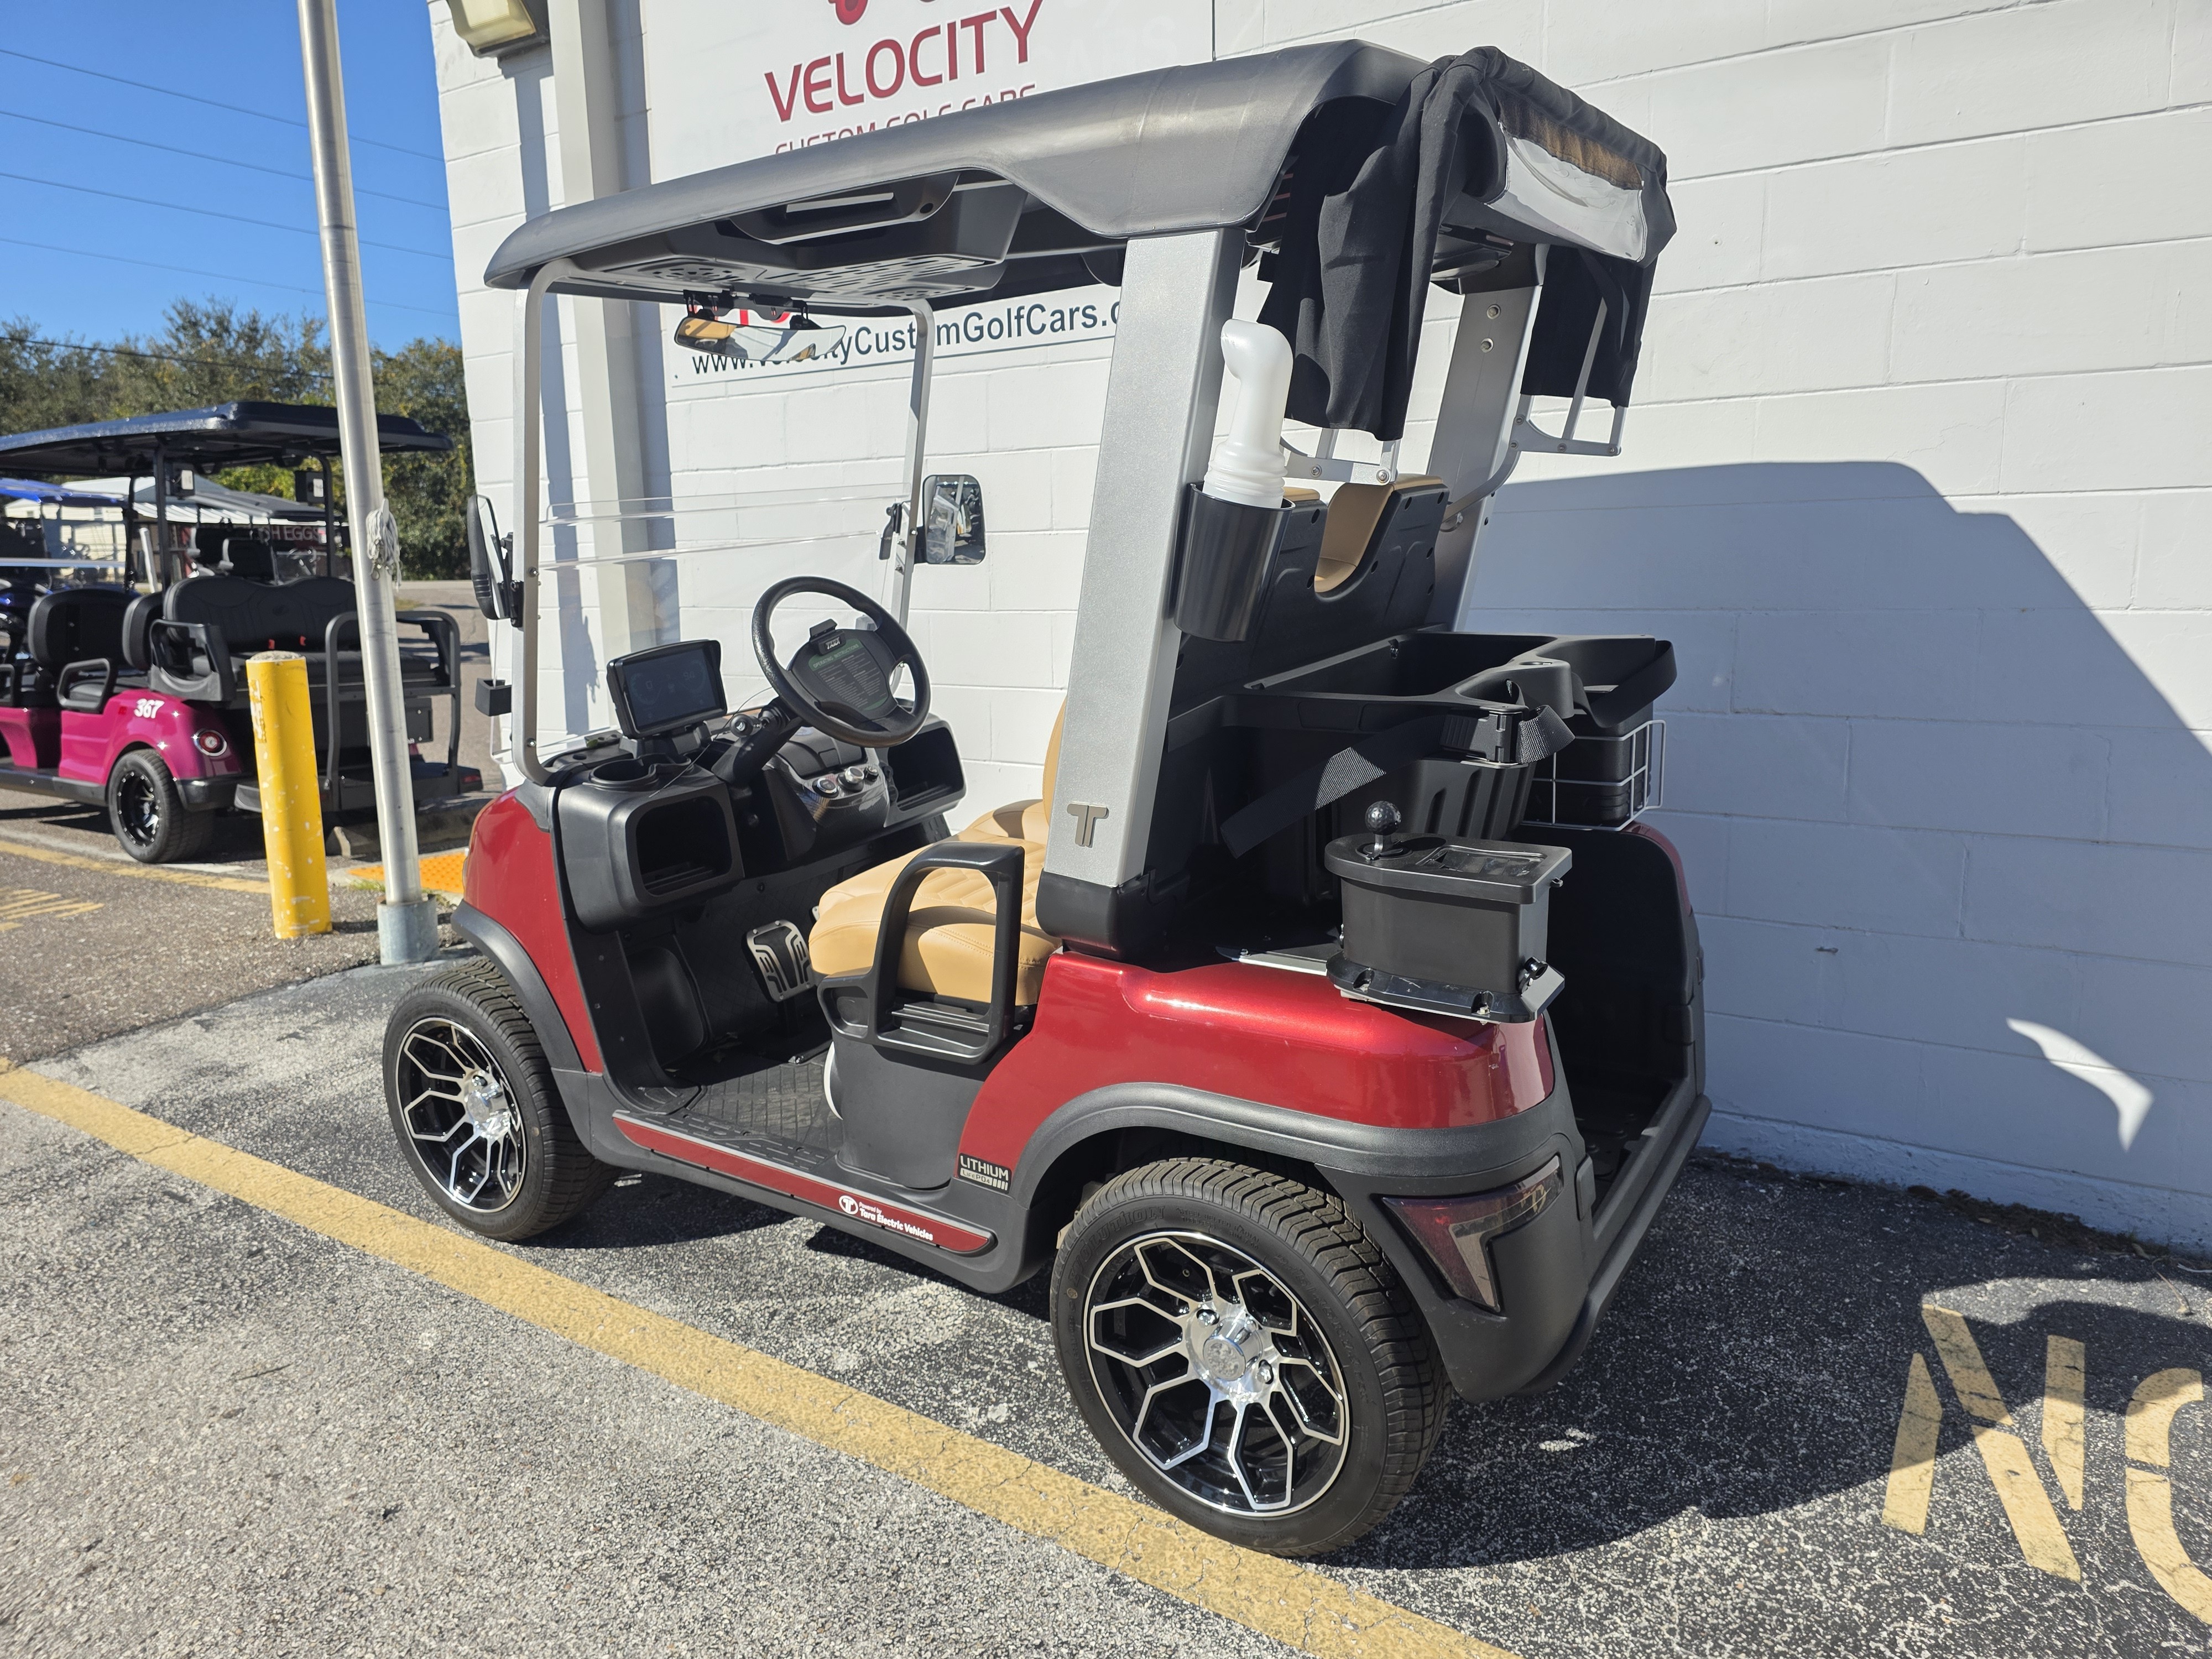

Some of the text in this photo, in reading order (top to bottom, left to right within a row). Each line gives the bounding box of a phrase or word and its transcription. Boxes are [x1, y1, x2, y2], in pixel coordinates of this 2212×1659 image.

[764, 0, 1043, 122] VELOCITY
[813, 643, 859, 668] OPERATING INSTRUCTIONS
[134, 698, 165, 718] 367
[960, 1155, 1009, 1181] LITHIUM
[859, 1202, 875, 1213] Powered
[859, 1208, 933, 1241] Tara Electric Vehicles
